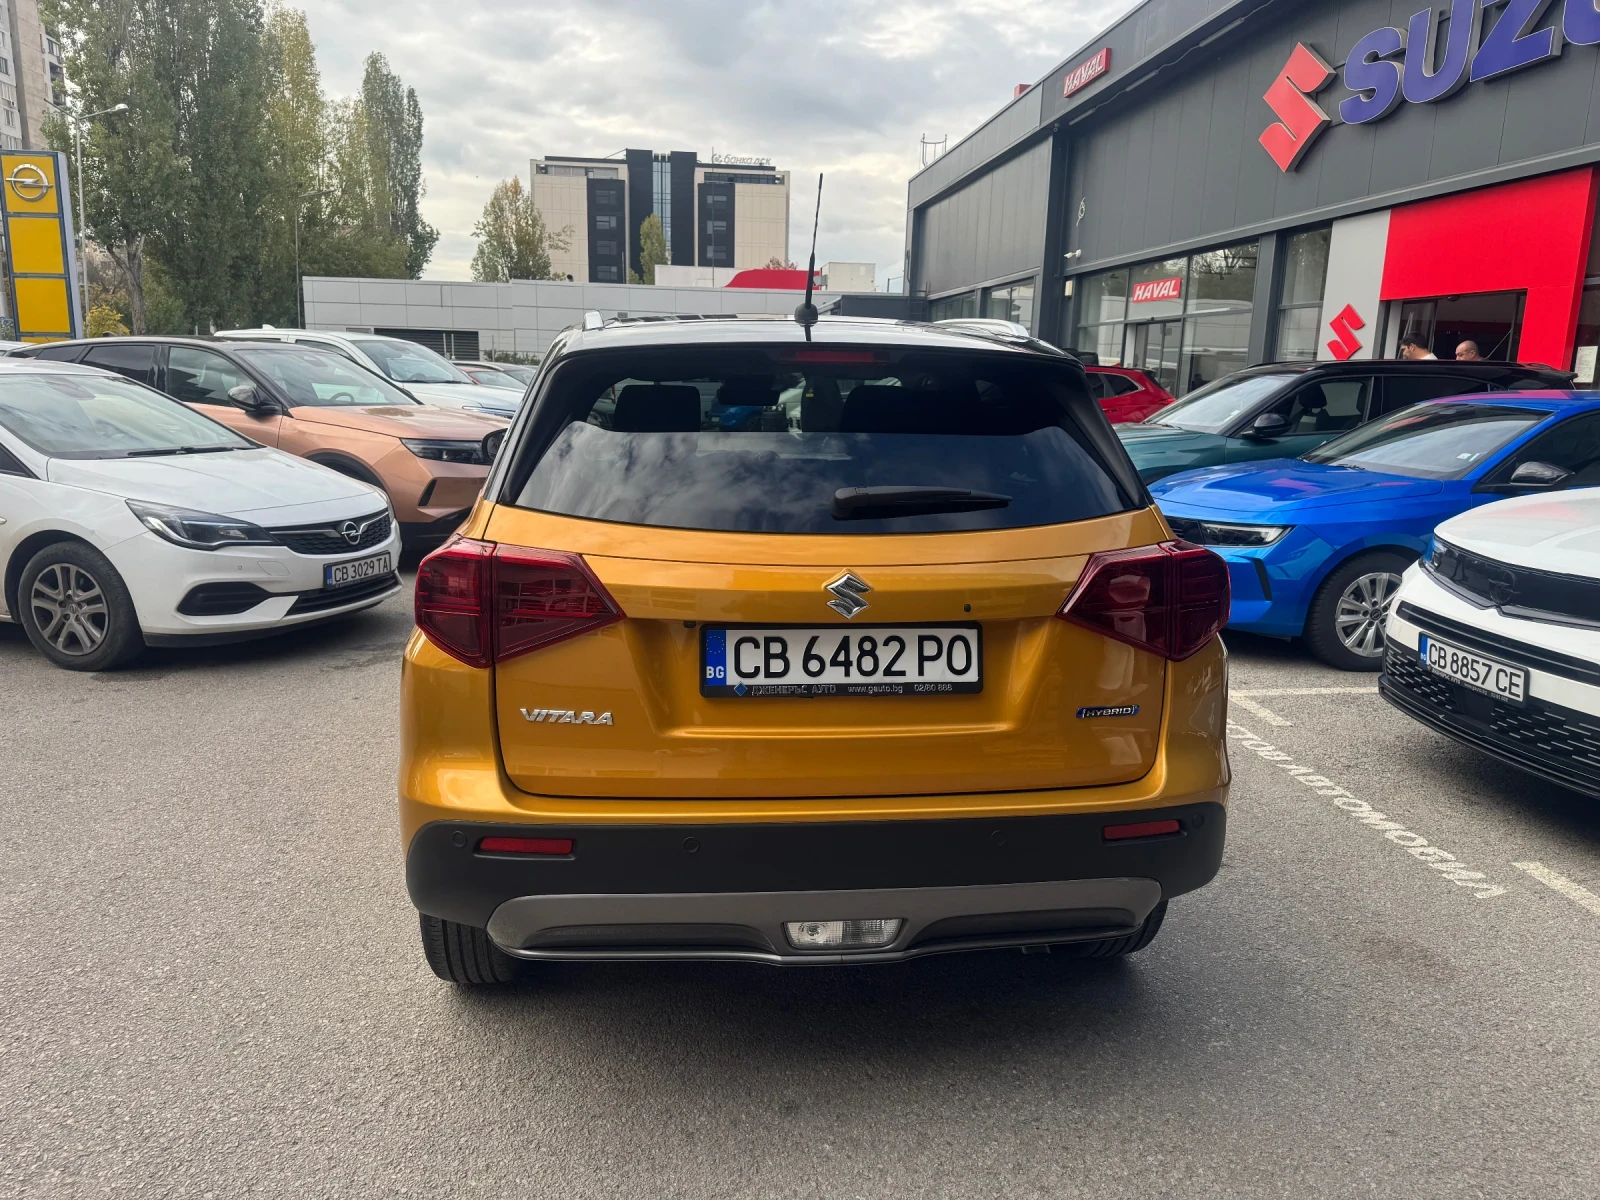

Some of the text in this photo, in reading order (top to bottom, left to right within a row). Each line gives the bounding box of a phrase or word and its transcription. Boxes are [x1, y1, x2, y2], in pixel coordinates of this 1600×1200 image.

[1339, 0, 1600, 124] SUZ
[1064, 53, 1104, 95] HAVAL
[724, 154, 752, 165] банка
[1133, 279, 1178, 301] HAVAL
[334, 566, 349, 583] CB
[351, 560, 375, 579] 3029
[377, 557, 388, 573] TA
[733, 634, 973, 679] CB 6482 PO
[706, 665, 725, 679] BG
[1429, 643, 1447, 670] CB
[1450, 652, 1493, 686] 8857
[1496, 668, 1522, 699] CE
[812, 684, 837, 694] АУТО
[847, 684, 903, 694] www.gauto.bg
[520, 708, 614, 725] VITARA
[1086, 707, 1132, 717] HYBRID
